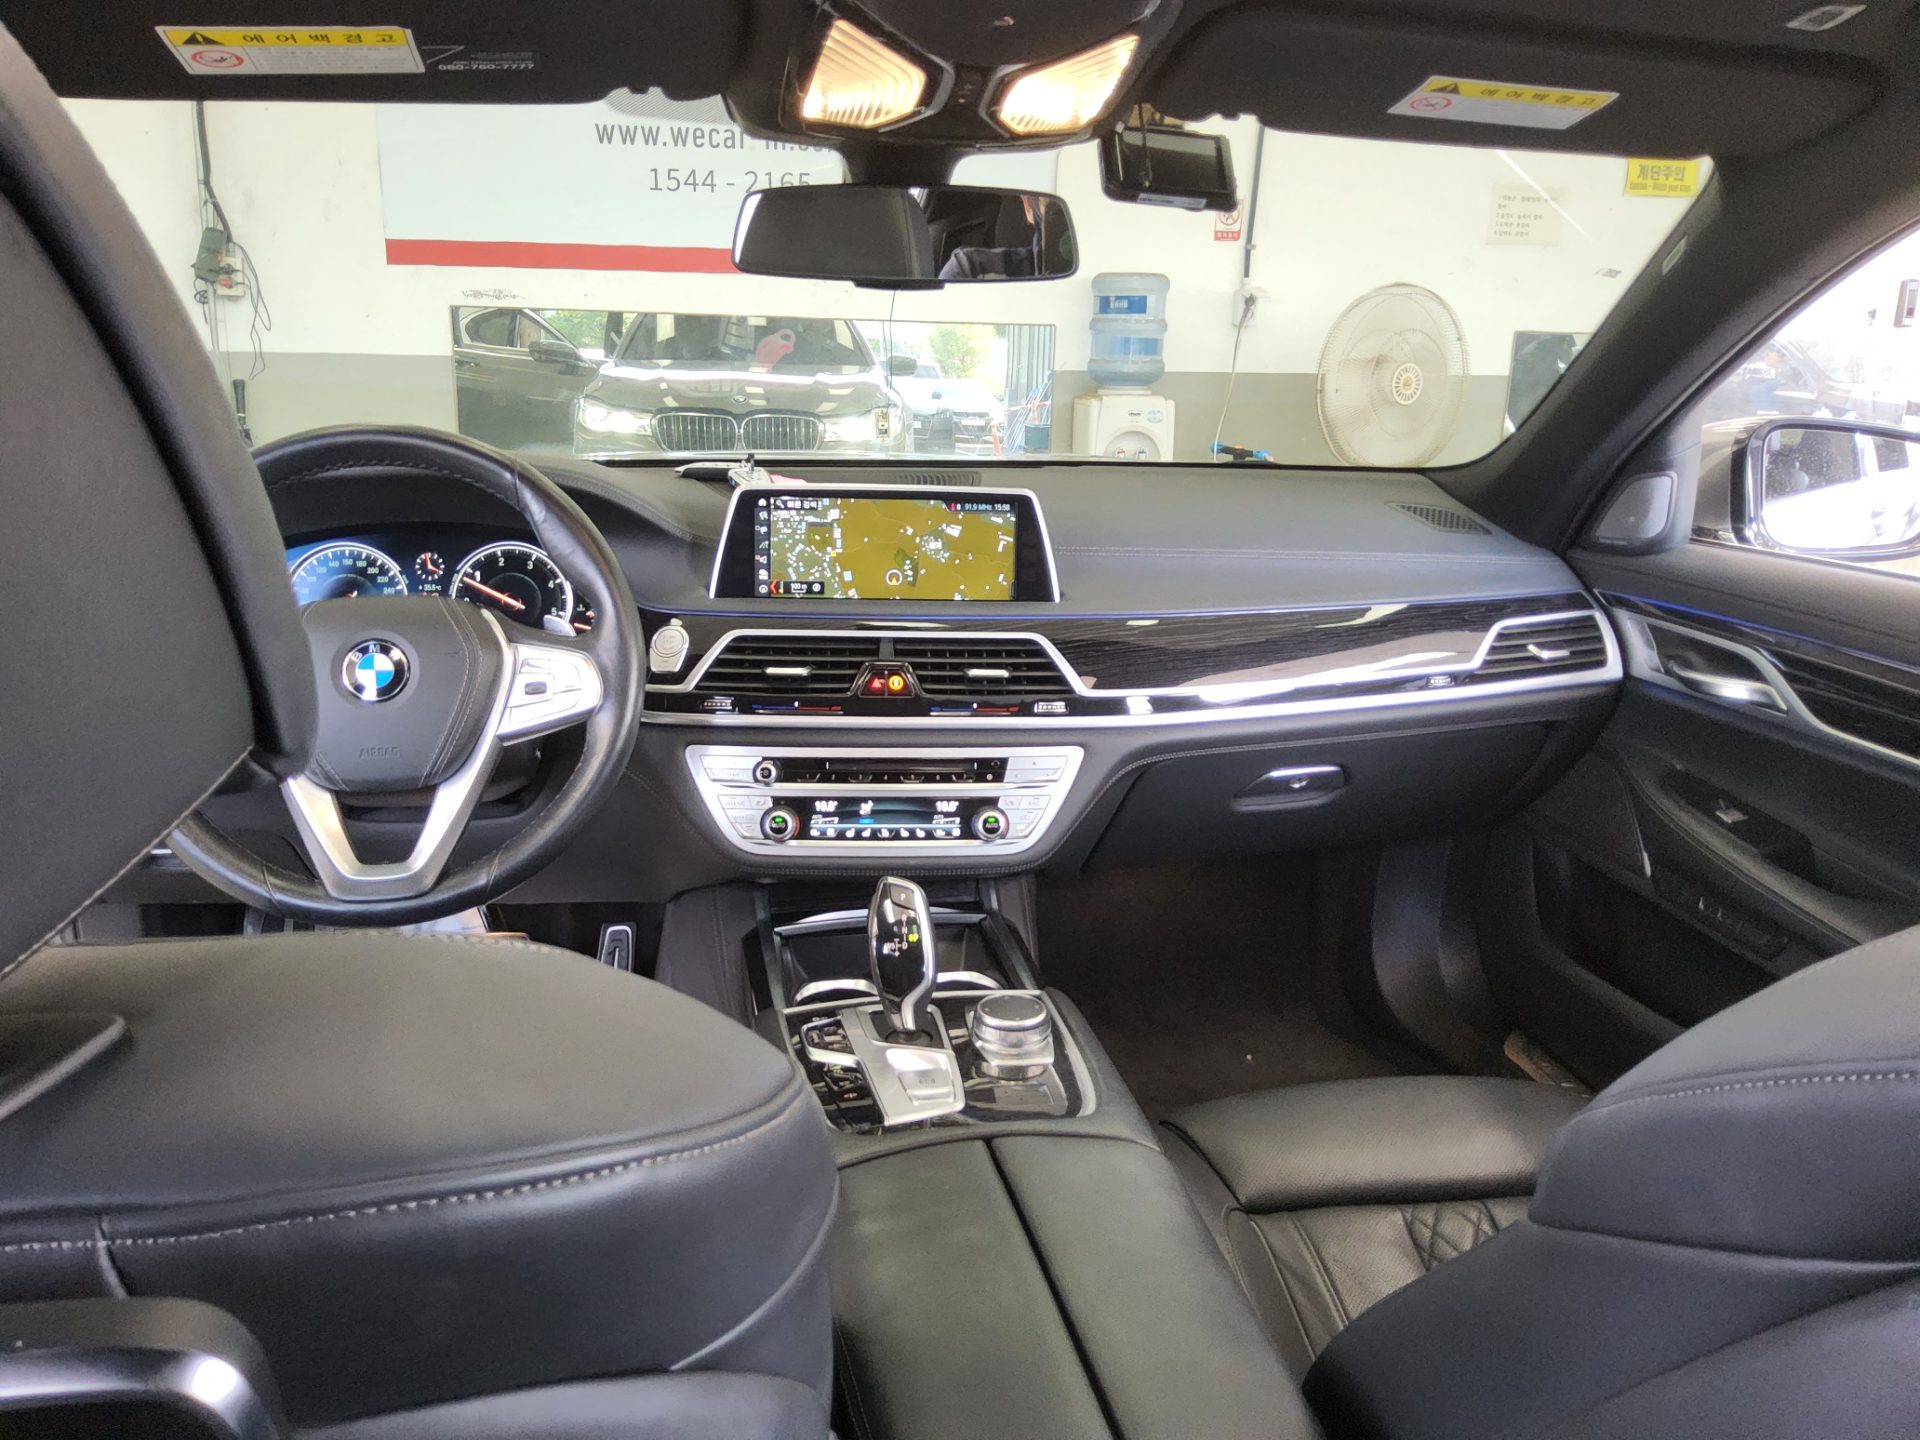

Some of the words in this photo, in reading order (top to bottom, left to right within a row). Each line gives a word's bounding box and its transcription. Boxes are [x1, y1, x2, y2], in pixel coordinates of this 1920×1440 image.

[1637, 164, 1686, 182] 계단주의
[499, 557, 505, 567] 2
[527, 561, 534, 570] 3
[474, 570, 481, 582] 1
[548, 582, 555, 590] 4
[551, 609, 558, 617] 5
